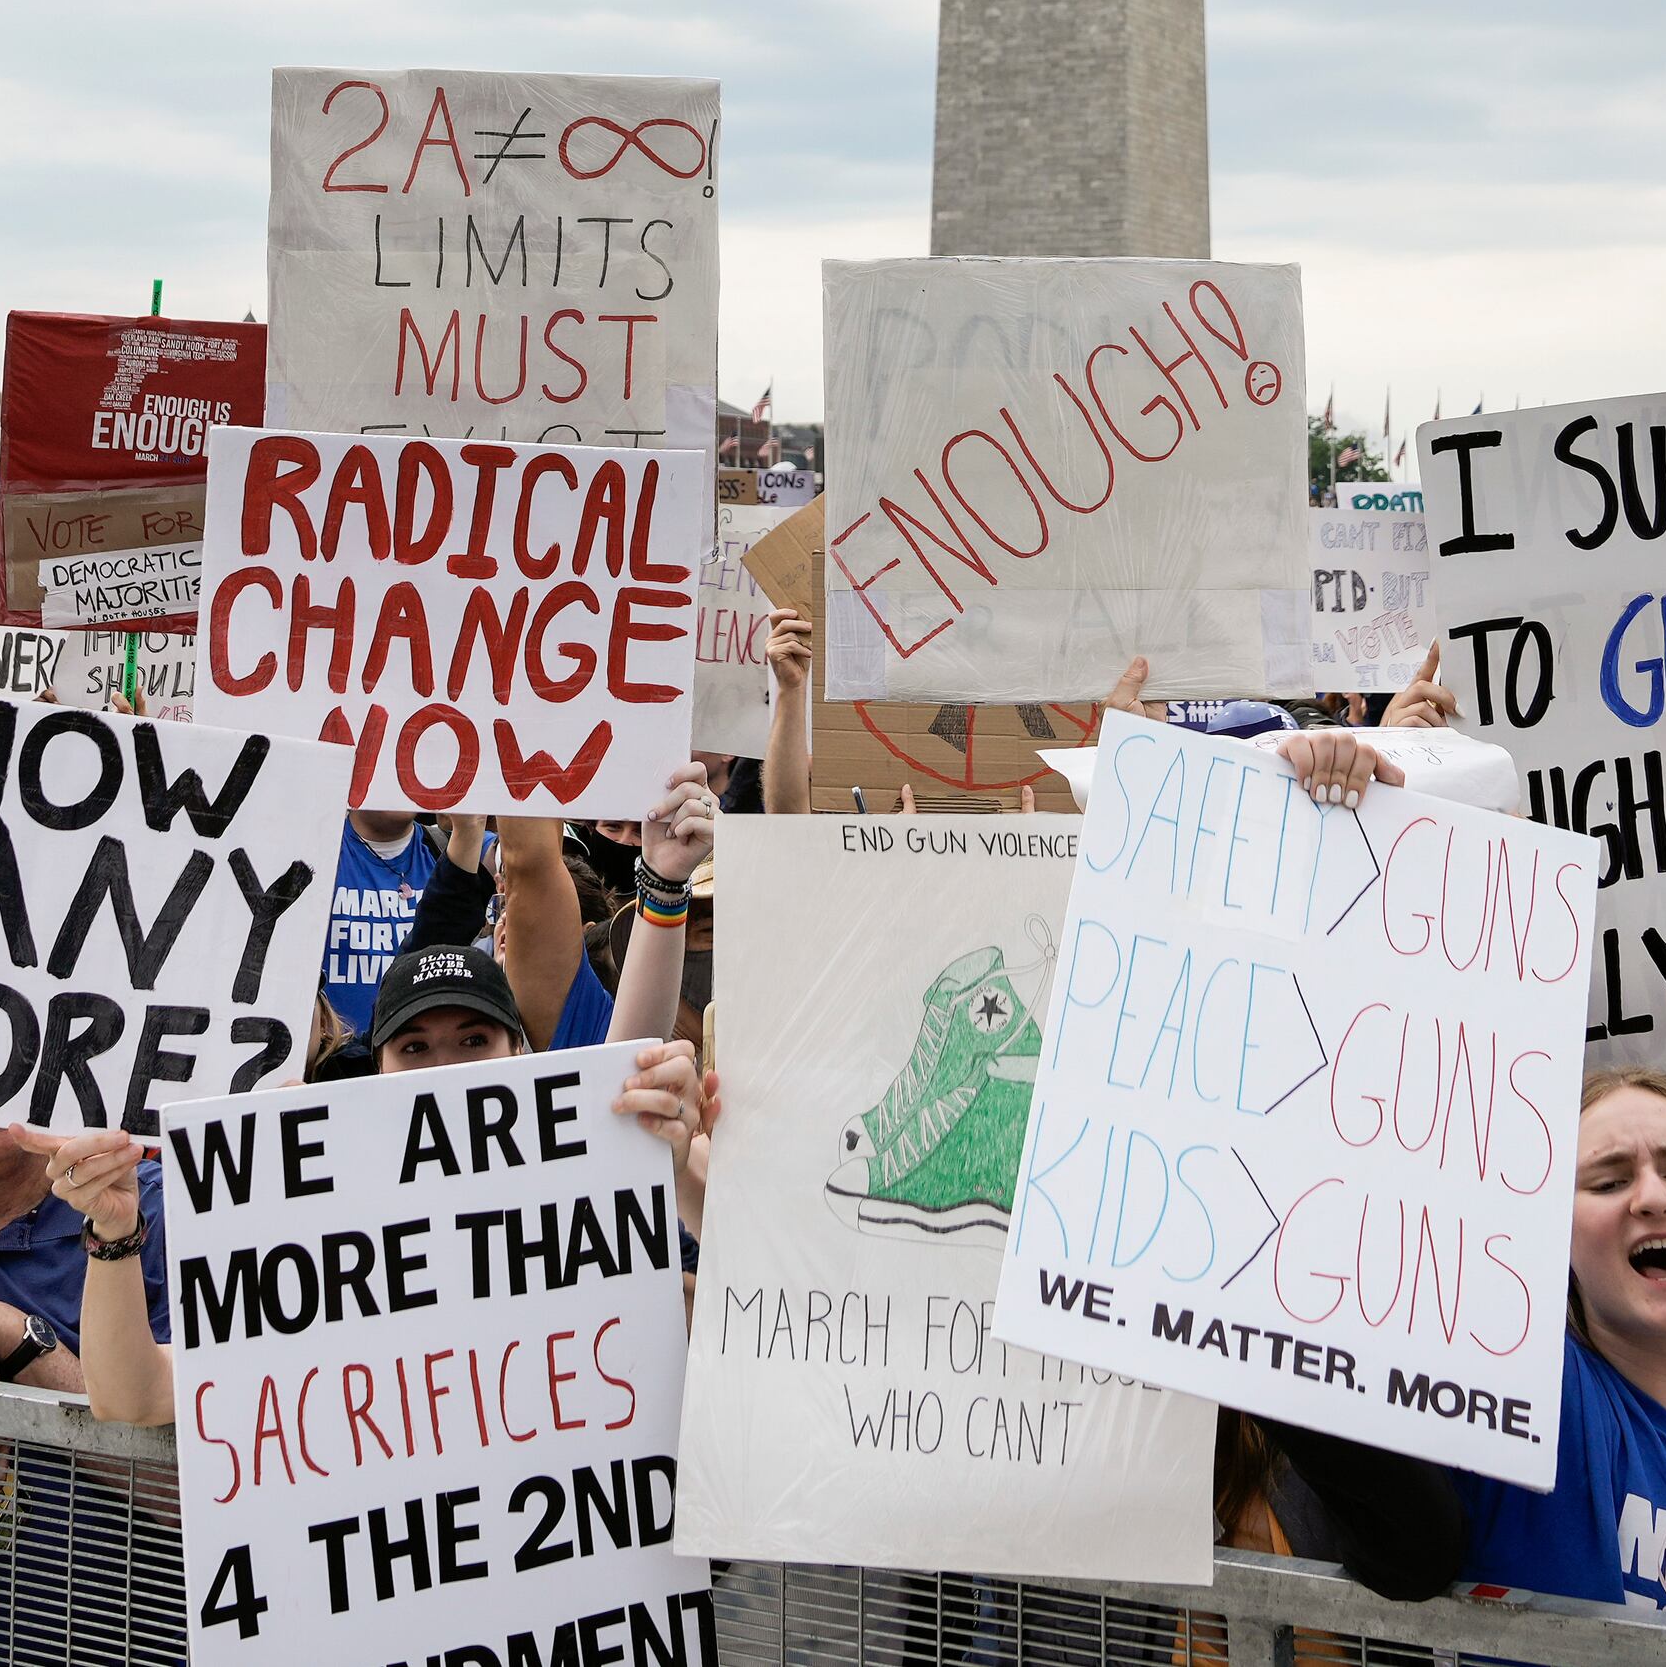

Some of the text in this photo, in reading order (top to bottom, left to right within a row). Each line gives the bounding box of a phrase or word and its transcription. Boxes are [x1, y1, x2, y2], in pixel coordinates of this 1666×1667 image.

[375, 215, 674, 300] LIMITS
[121, 345, 159, 358] COLUMBINE
[161, 339, 206, 353] SANDY HOOK
[395, 308, 658, 404] MUST
[143, 394, 231, 422] ENOUGH IS
[135, 452, 159, 462] MARCH
[830, 279, 1281, 658] ENOUGH!
[1430, 430, 1514, 558] I
[27, 507, 113, 552] VOTE
[142, 511, 204, 540] FOR
[240, 437, 691, 583] RADICAL
[52, 550, 201, 587] DEMOCRATIC
[1382, 571, 1430, 611] BUT
[210, 566, 693, 706] CHANGE
[1335, 609, 1419, 664] VOTE
[1448, 616, 1556, 729] TO
[842, 824, 1079, 860] END GUN VIOLENCE
[330, 920, 394, 951] FOR
[412, 966, 475, 985] MATTER
[418, 952, 466, 967] BLACK
[420, 959, 465, 973] LIVES
[169, 1071, 588, 1214] WE ARE
[179, 1184, 671, 1350] MORE THAN
[721, 1286, 889, 1369] MARCH
[1038, 1268, 1543, 1444] WE. MATTER. MORE.
[195, 1317, 635, 1504] SACRIFICES
[844, 1383, 1084, 1466] WHO CAN'T
[200, 1544, 269, 1640] 4
[308, 1485, 489, 1615] THE
[506, 1454, 676, 1573] 2ND
